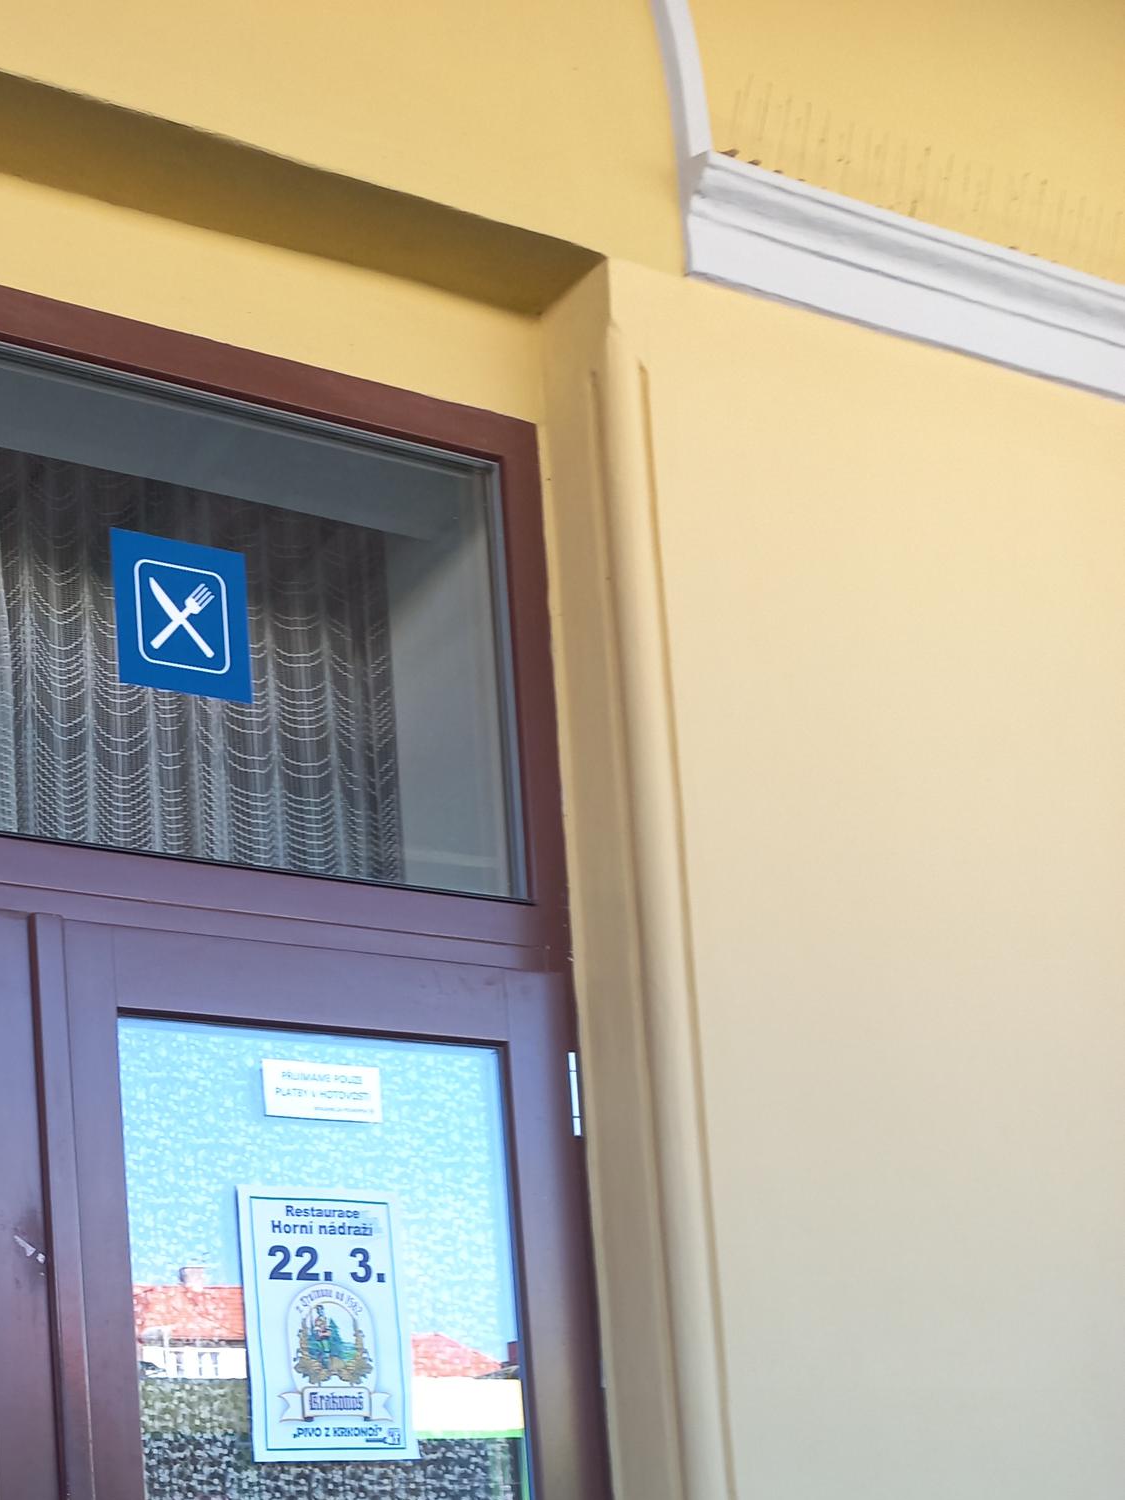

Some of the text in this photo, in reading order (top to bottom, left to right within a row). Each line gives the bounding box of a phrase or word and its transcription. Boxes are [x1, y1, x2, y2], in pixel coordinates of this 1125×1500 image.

[285, 1205, 360, 1218] Restaurace
[271, 1220, 373, 1236] Horní nádraží
[268, 1245, 386, 1283] 22. 3.
[324, 1427, 331, 1437] Z
